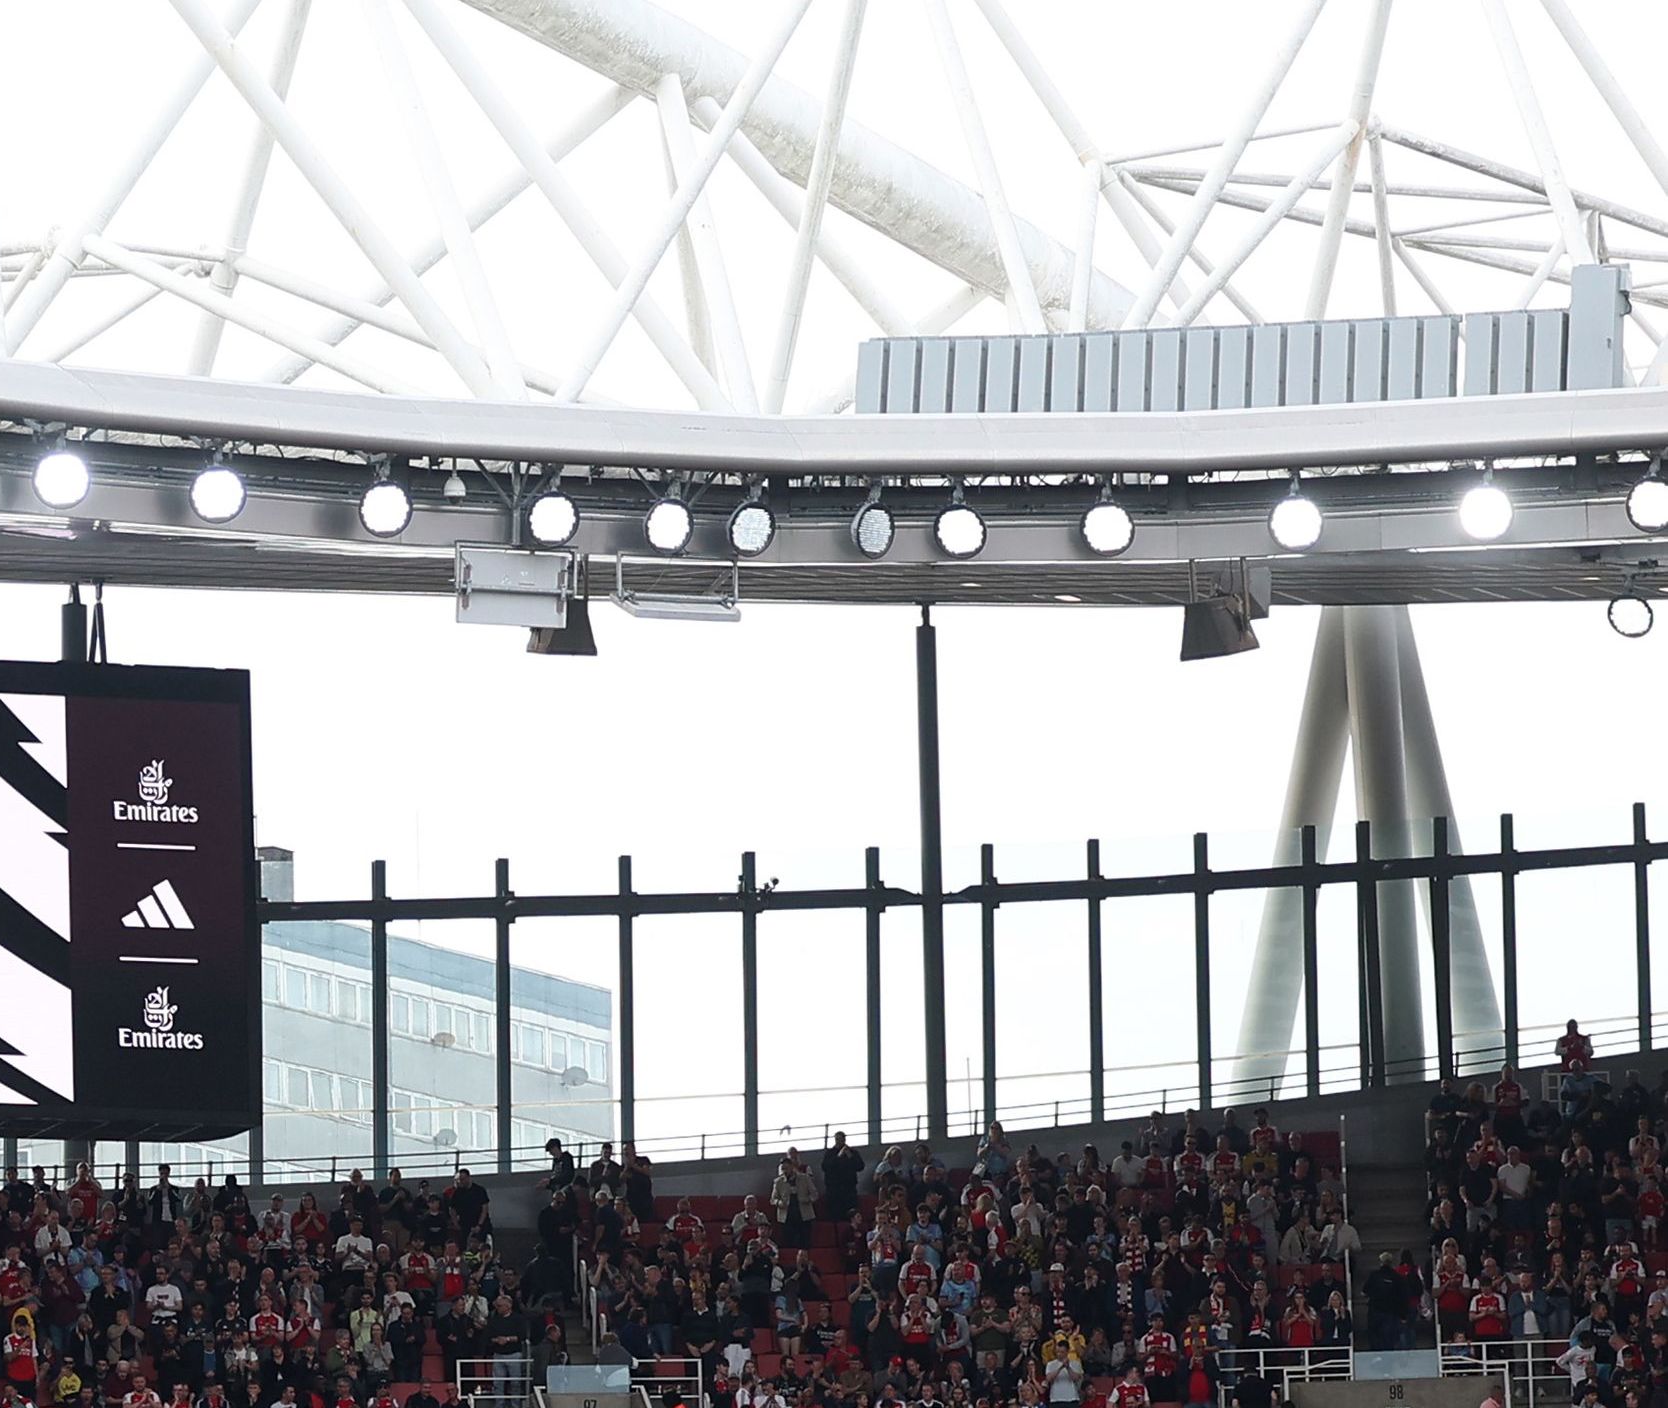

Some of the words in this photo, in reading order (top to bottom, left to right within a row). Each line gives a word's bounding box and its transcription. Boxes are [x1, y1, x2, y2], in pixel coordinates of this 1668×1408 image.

[112, 799, 199, 824] Emirates
[117, 1026, 204, 1051] Emirates
[1389, 1384, 1404, 1400] 98
